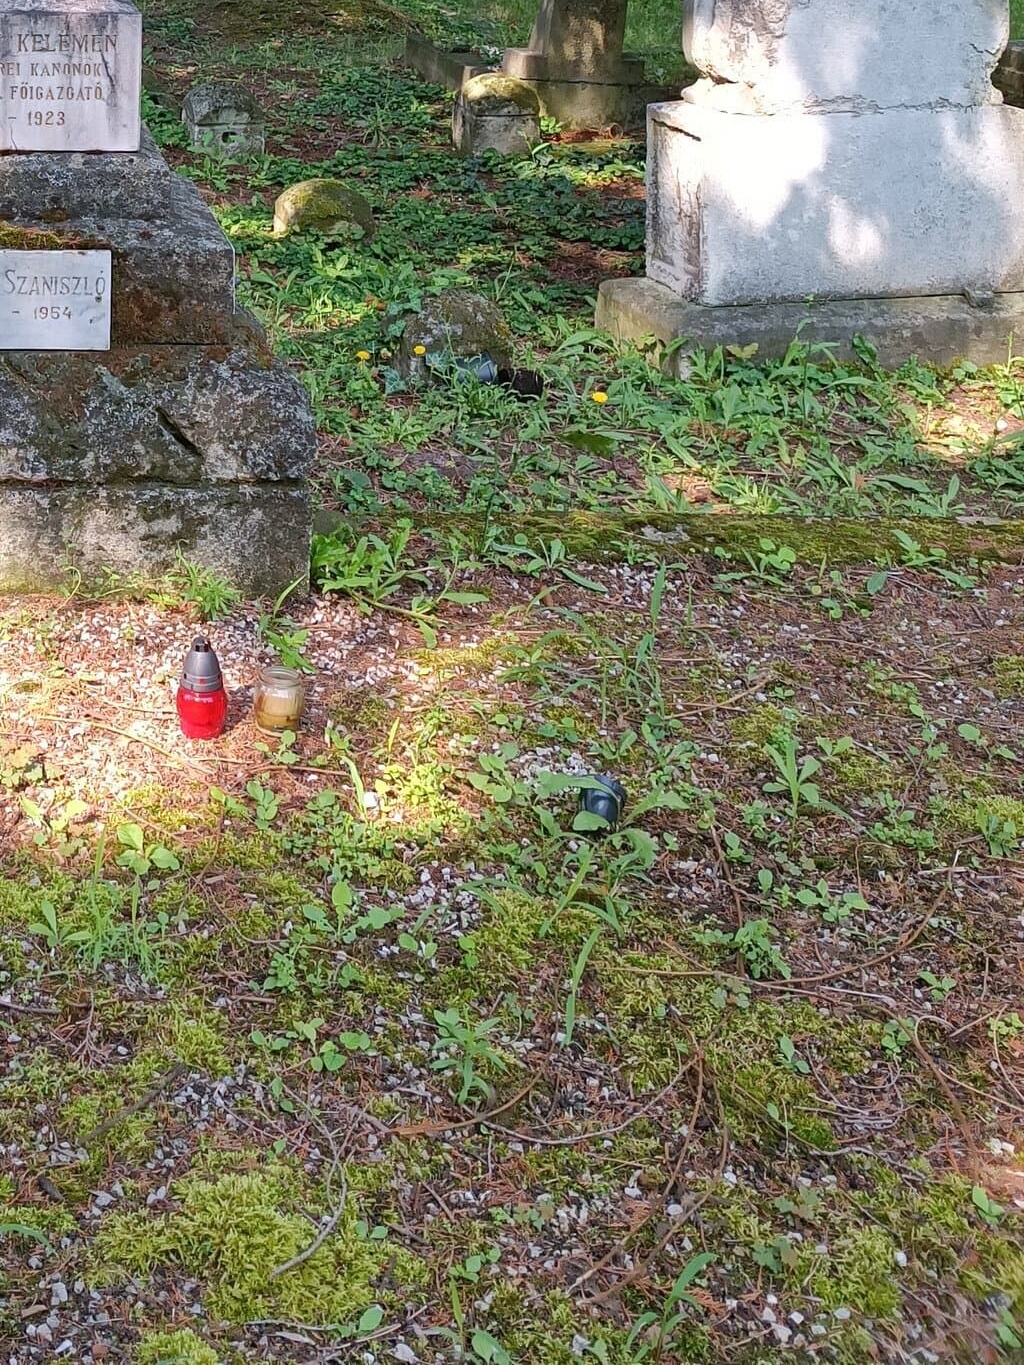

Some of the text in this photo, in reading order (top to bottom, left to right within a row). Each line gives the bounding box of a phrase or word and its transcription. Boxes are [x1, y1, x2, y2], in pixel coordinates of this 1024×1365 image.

[16, 33, 119, 54] KELEMEN
[30, 61, 103, 78] KANONOK
[27, 110, 66, 126] 1923
[33, 305, 74, 320] 1954
